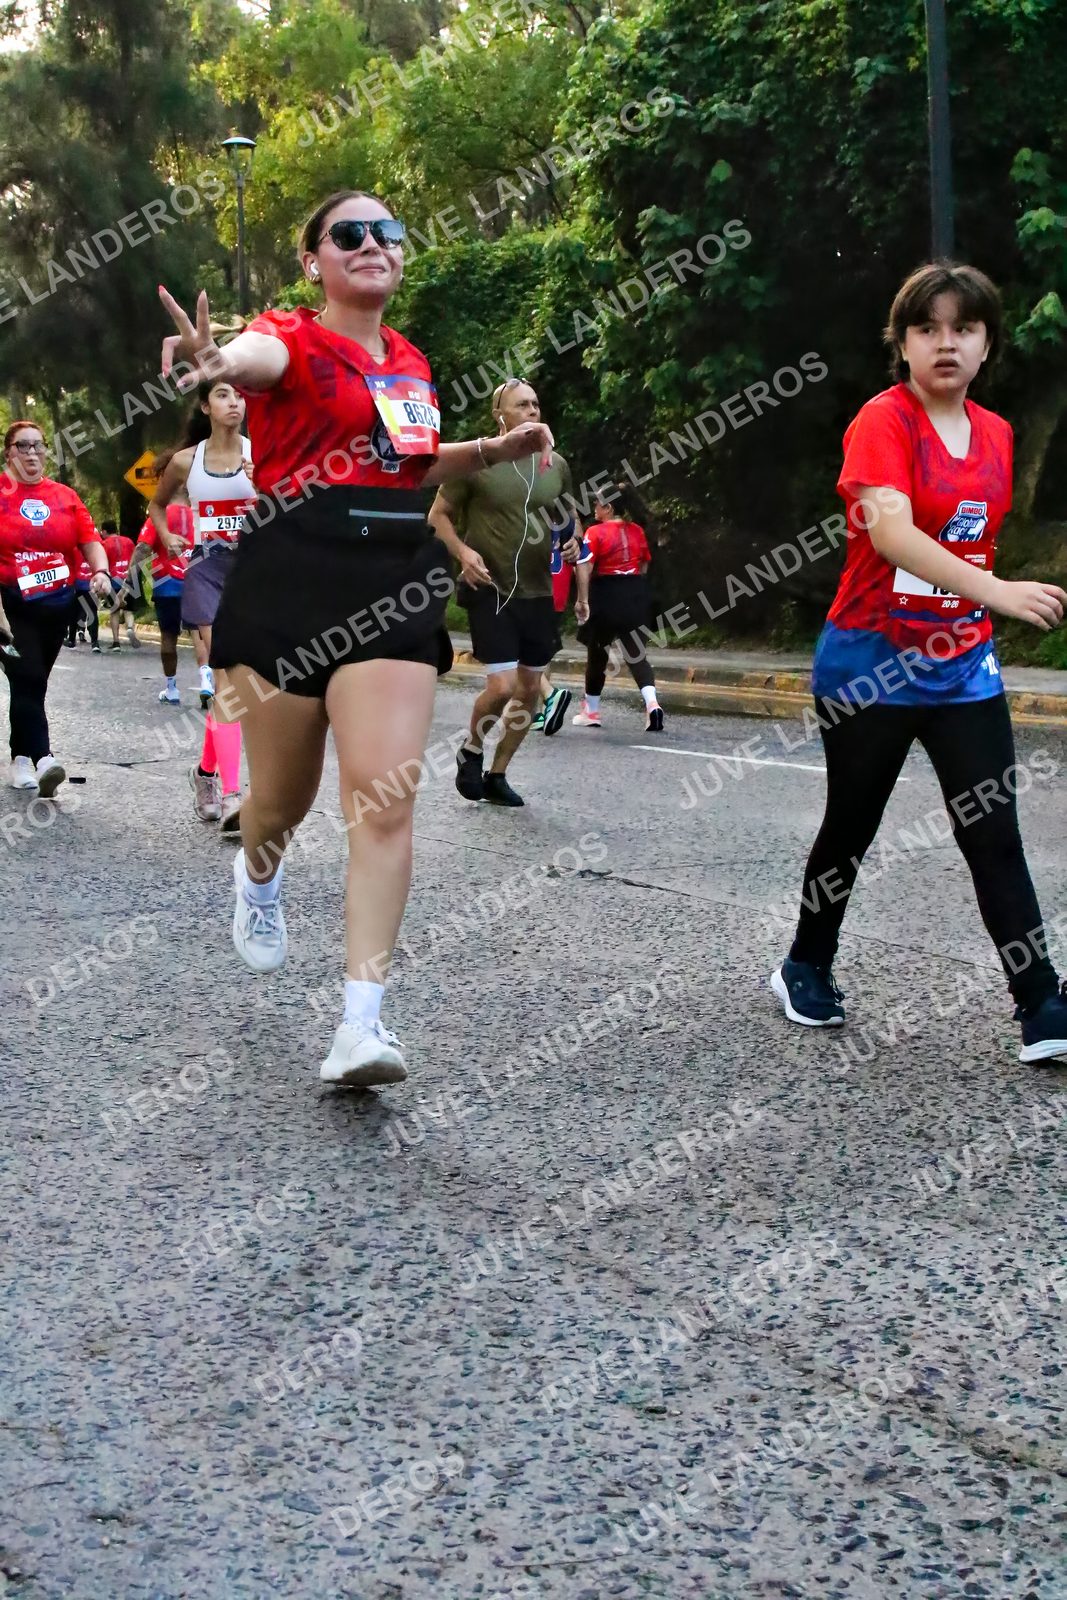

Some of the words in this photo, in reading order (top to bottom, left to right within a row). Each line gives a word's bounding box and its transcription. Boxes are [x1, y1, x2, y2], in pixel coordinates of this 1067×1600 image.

[961, 507, 983, 515] BIMBO
[217, 516, 244, 530] 2973
[34, 569, 57, 585] 3207
